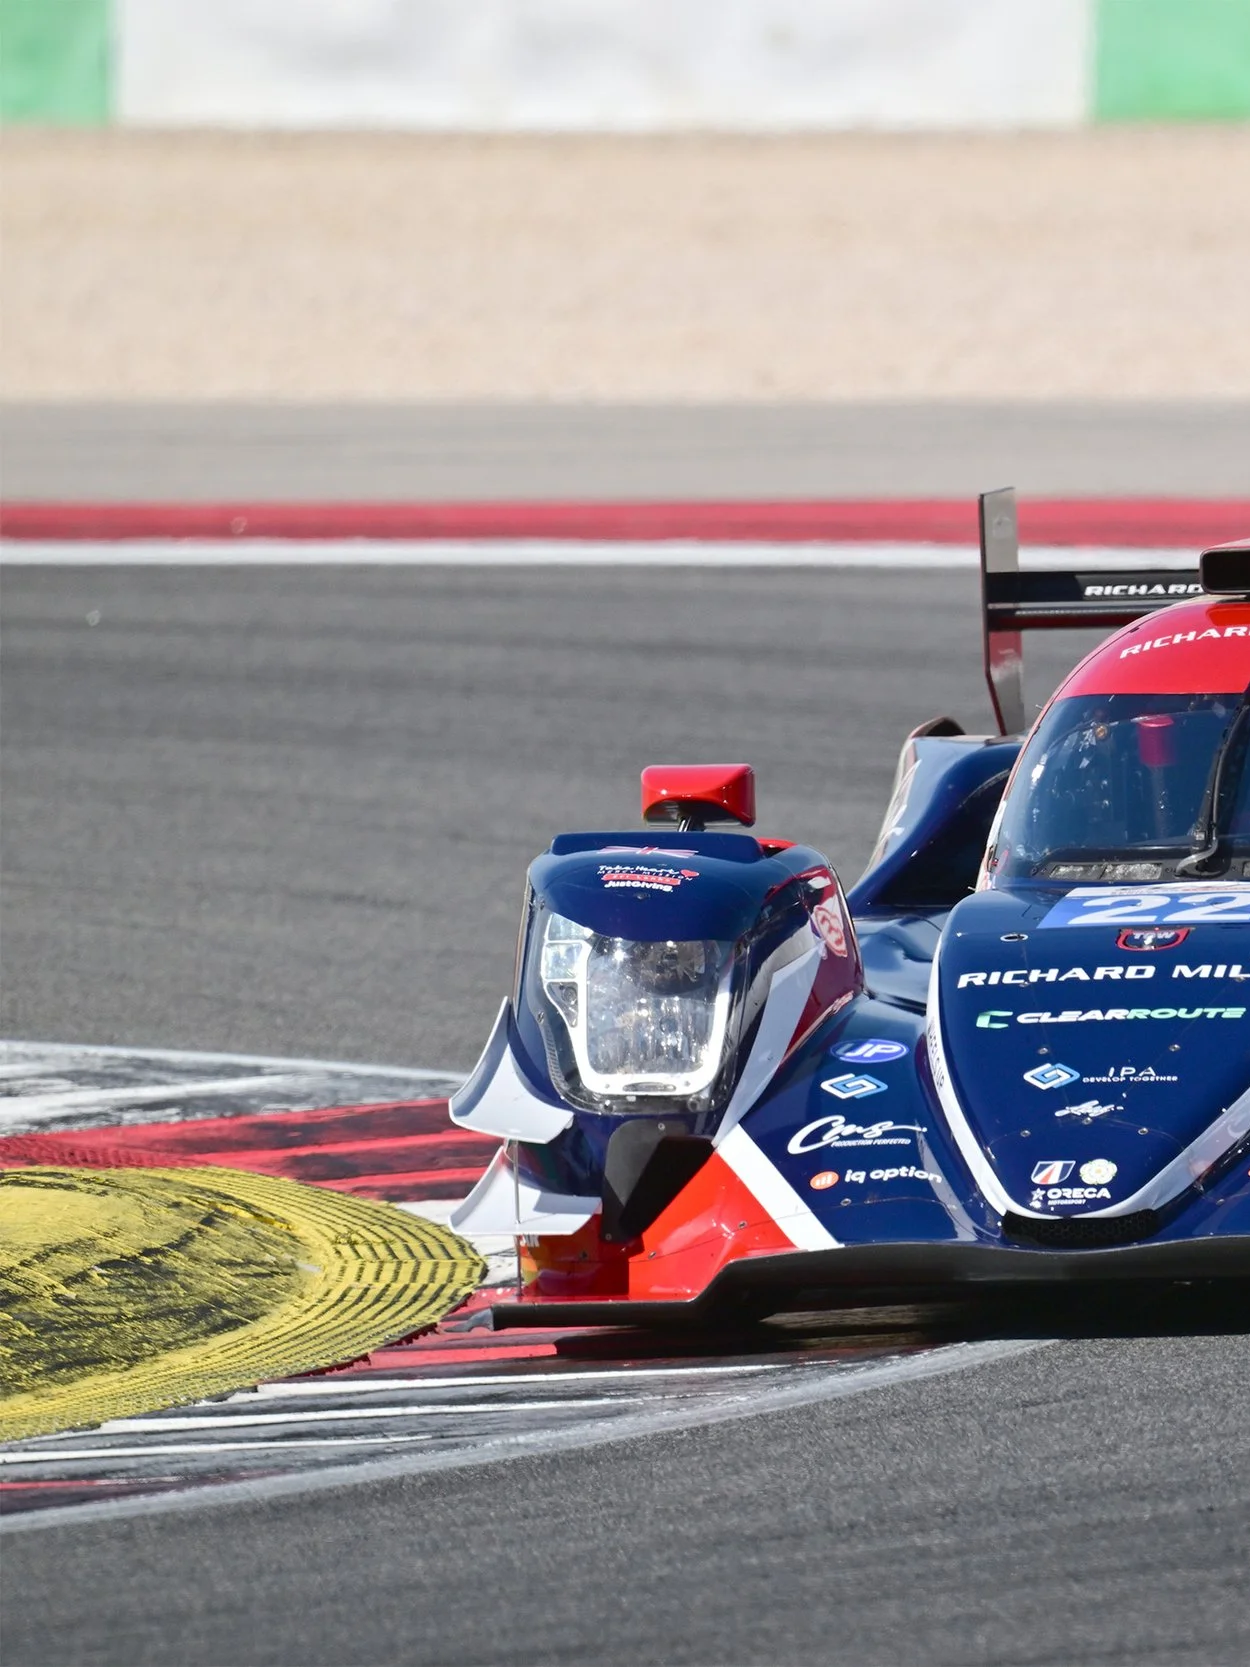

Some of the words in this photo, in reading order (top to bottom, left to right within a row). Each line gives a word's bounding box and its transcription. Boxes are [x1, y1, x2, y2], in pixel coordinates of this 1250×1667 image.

[1083, 583, 1204, 597] RICHARD
[957, 964, 1156, 989] RICHARD
[1016, 1007, 1247, 1024] CLEARROUTE
[1082, 1075, 1126, 1083] DEVELOP
[1108, 1066, 1157, 1078] IPA
[844, 1168, 867, 1184] iq
[869, 1165, 943, 1184] option
[1046, 1187, 1112, 1199] ORECA
